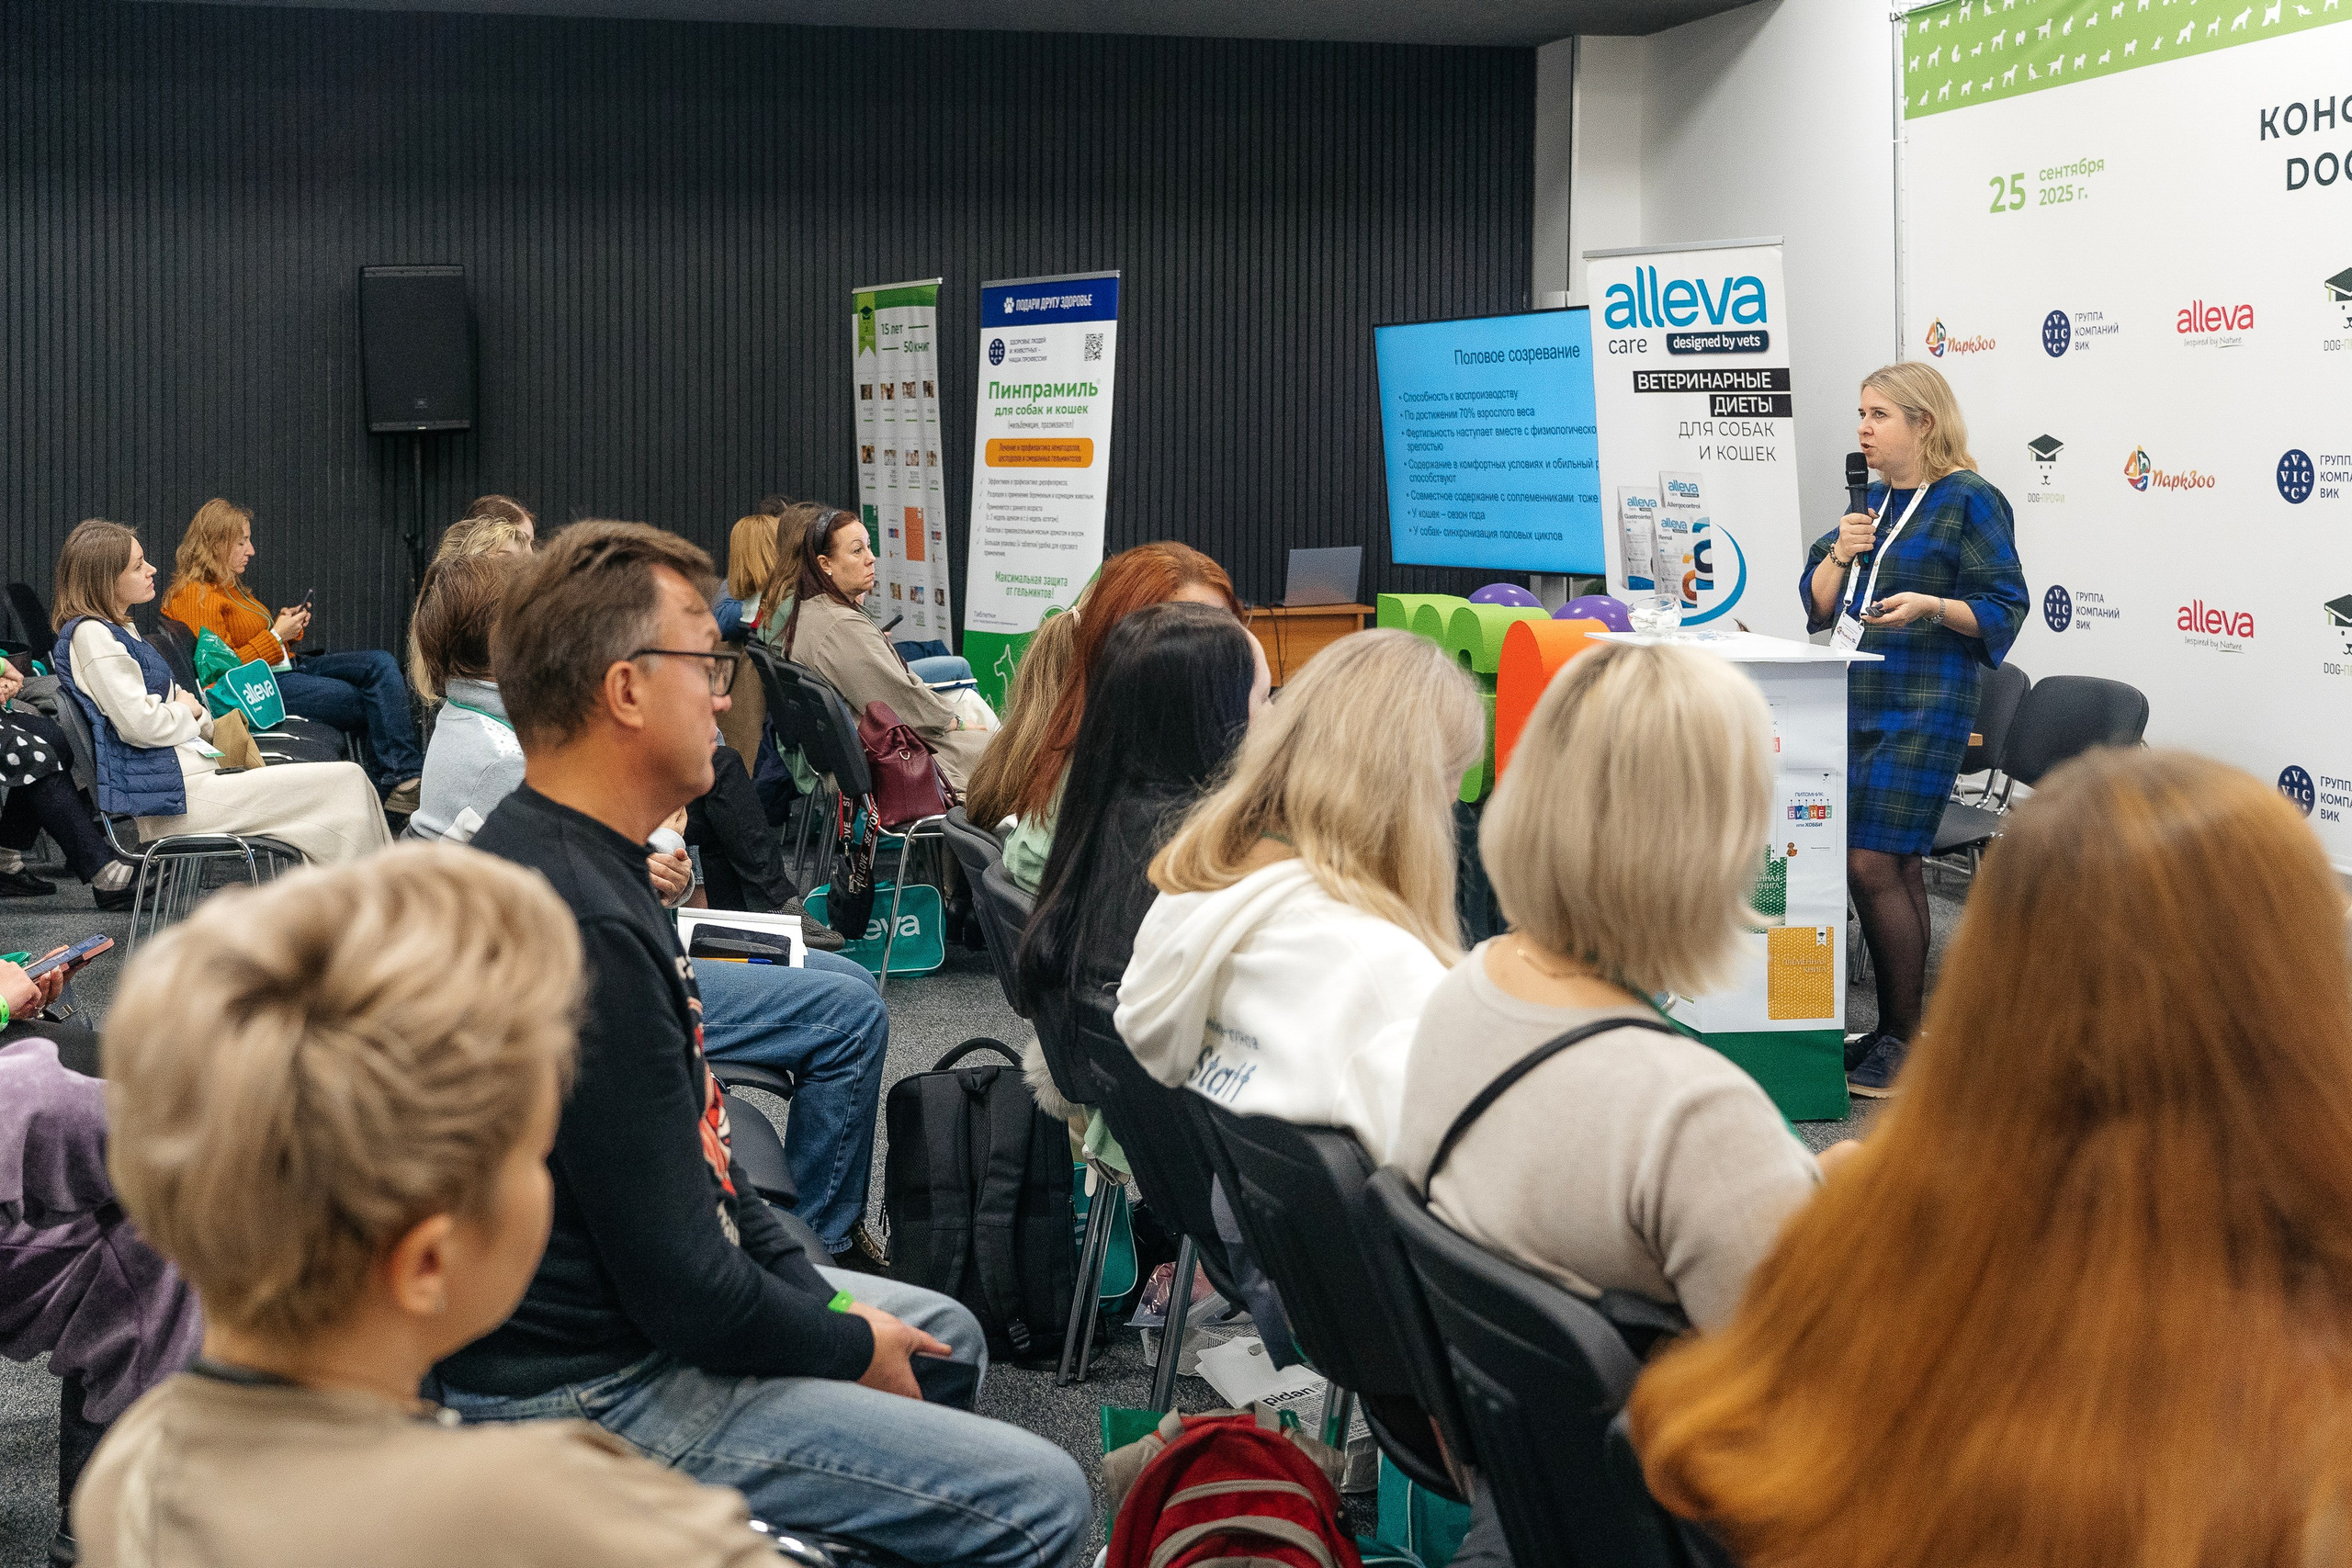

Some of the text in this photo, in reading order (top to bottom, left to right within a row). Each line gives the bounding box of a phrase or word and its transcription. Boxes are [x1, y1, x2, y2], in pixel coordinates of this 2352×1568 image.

[2039, 157, 2105, 182] сентября
[1989, 172, 2026, 213] 25
[2039, 185, 2088, 207] 2025 г.
[1016, 294, 1092, 312] ПОДАРИ ДРУГУ ЗДОРОВЬЕ
[1605, 265, 1767, 330] alleva
[2075, 311, 2103, 322] ГРУППА
[2177, 299, 2254, 333] alleva
[881, 323, 903, 335] 15 лет
[2075, 323, 2119, 337] КОМПАНИЙ
[903, 341, 913, 353] 50
[1609, 334, 1761, 354] care designed by vets
[2075, 341, 2090, 351] ВИК
[2184, 336, 2242, 348] Inspired by Nature
[1454, 344, 1580, 366] Половое созревание
[1637, 372, 1772, 390] ВЕТЕРИНАРНЫЕ
[1403, 391, 1449, 402] Способность
[1455, 389, 1518, 402] воспроизводству
[994, 403, 1089, 417] для собак и кошек
[1714, 396, 1773, 415] ДИЕТЫ
[1405, 408, 1535, 421] По достижении 70% взрослого веса
[1406, 429, 1454, 439] Фертильность
[1456, 428, 1493, 439] наступает
[1496, 427, 1521, 436] вместе
[1524, 427, 1529, 435] с
[1679, 421, 1775, 439] ДЛЯ СОБАК
[1407, 443, 1443, 453] зрелостью
[1700, 446, 1777, 462] И КОШЕК
[1408, 459, 1452, 471] Содержание
[1459, 459, 1506, 471] комфортных
[1508, 460, 1544, 471] условиях
[1553, 457, 1593, 468] обильный
[2320, 455, 2352, 466] ГРУПП
[1409, 472, 1456, 485] способствуют
[1668, 479, 1699, 493] alleva
[1410, 490, 1452, 501] Совместное
[1454, 492, 1499, 503] содержание
[1508, 493, 1574, 502] соплеменниками
[1577, 494, 1599, 503] тоже
[2320, 488, 2340, 499] ВИК
[1626, 496, 1657, 508] alleva
[1419, 511, 1440, 519] кошек
[1447, 511, 1467, 519] сезон
[1469, 512, 1486, 522] года
[1660, 517, 1688, 530] alleva
[1443, 528, 1498, 539] синхронизация
[1499, 531, 1532, 539] половых
[1534, 532, 1563, 542] циклов
[995, 570, 1069, 588] Максимальная защита
[1006, 587, 1012, 596] от
[2075, 592, 2105, 604] ГРУППА
[2075, 606, 2120, 619] КОМПАНИЙ
[2177, 599, 2254, 638] alleva
[2075, 620, 2091, 630] ВИК
[2184, 636, 2243, 650] Inspired by Nature
[243, 679, 276, 705] alleva
[2321, 775, 2352, 792] ГРУПП
[1789, 809, 1832, 819] БИЗНЕС
[2321, 808, 2340, 823] ВИК
[860, 852, 868, 874] LOVE
[863, 914, 920, 940] eva
[1804, 965, 1827, 974] КНИГА
[1188, 1045, 1257, 1102] Staff
[1261, 1385, 1318, 1406] pidan
